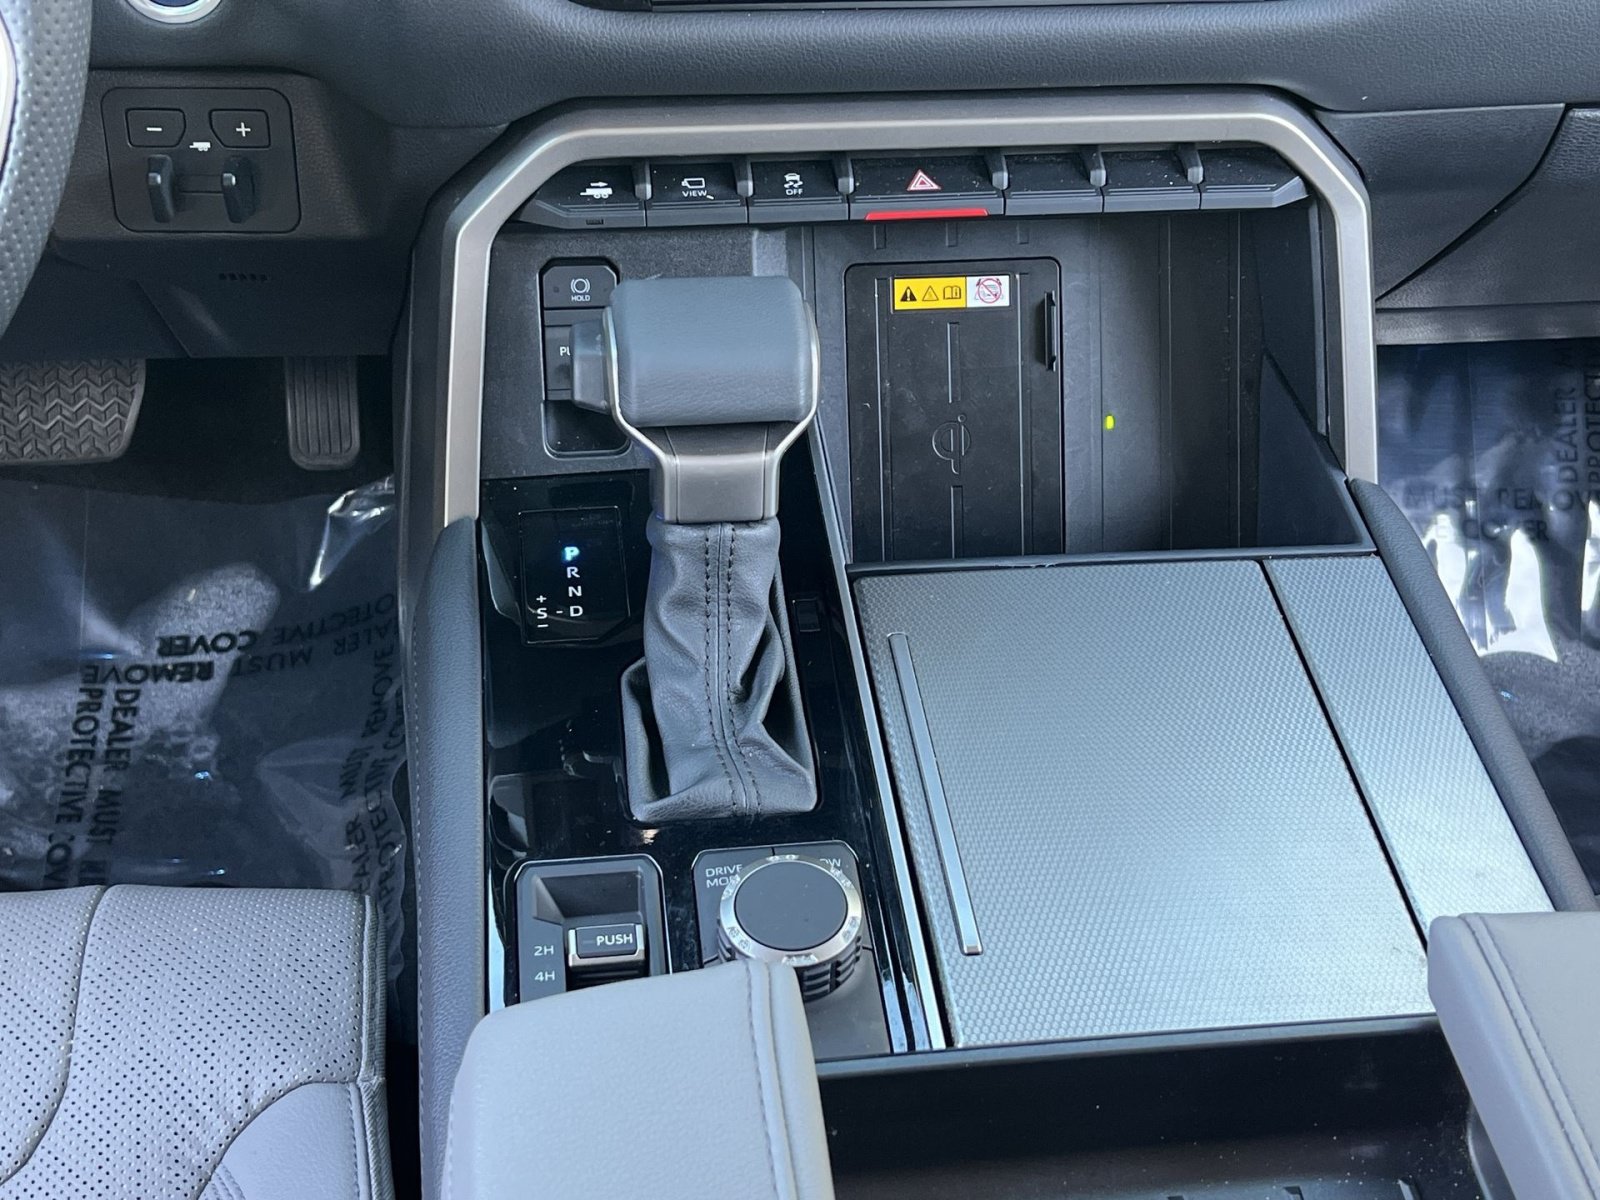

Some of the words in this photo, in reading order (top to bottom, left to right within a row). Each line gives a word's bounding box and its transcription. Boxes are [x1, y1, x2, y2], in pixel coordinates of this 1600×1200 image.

[786, 188, 803, 196] OFF
[1554, 384, 1578, 484] DEALER
[564, 546, 580, 561] P
[566, 566, 580, 578] R
[568, 586, 582, 597] N
[537, 607, 548, 619] S
[569, 605, 584, 617] D
[155, 629, 258, 658] COVER
[232, 647, 313, 676] MUST
[81, 661, 215, 685] REMOVE
[104, 690, 141, 772] DEALER
[55, 688, 104, 825] PROTECTIVE
[596, 933, 633, 946] PUSH
[533, 945, 554, 956] 2H
[534, 970, 556, 982] 4H
